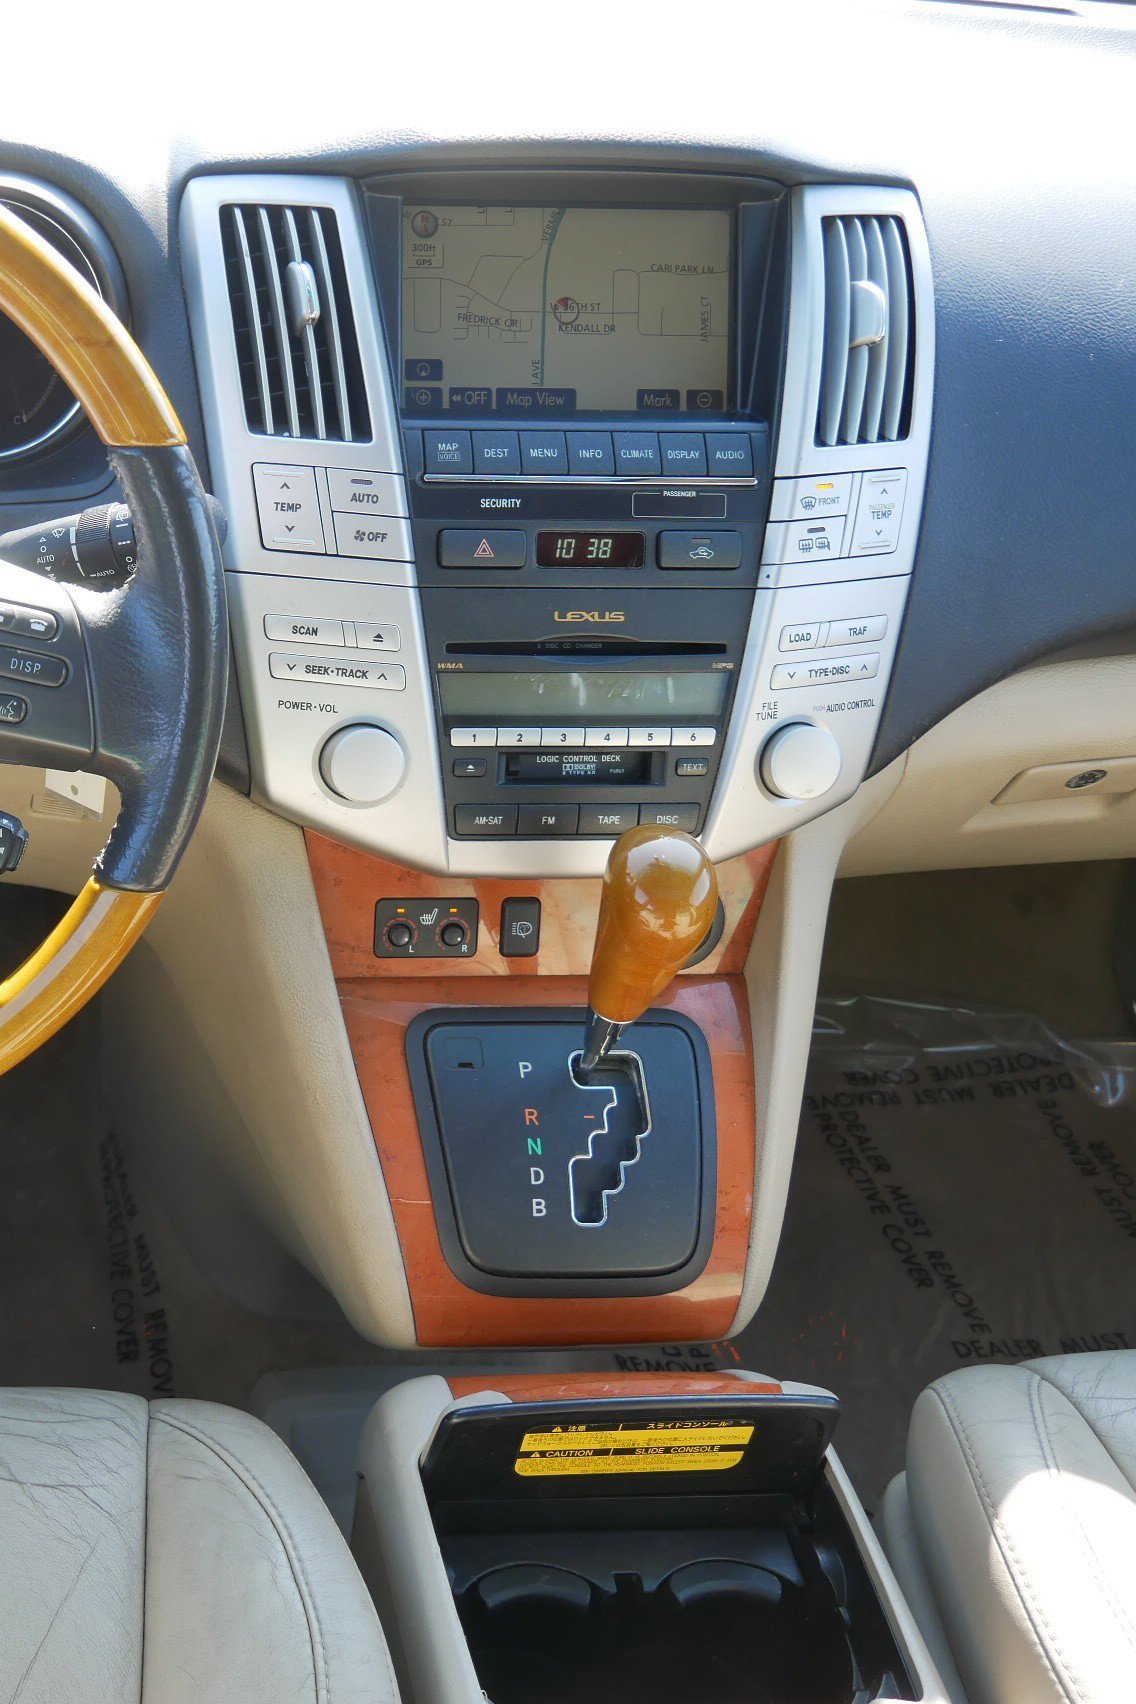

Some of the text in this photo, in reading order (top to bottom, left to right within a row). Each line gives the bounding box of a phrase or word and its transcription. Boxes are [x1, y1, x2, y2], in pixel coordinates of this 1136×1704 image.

[411, 243, 436, 253] 300ft
[416, 259, 433, 267] GPS
[674, 264, 700, 274] PARK
[589, 302, 602, 312] ST
[457, 312, 501, 327] FREDRICK
[558, 323, 616, 333] KENDALL DR
[700, 309, 710, 343] JAMES
[531, 359, 540, 380] AVE
[464, 390, 488, 405] OFF
[506, 391, 566, 408] Map View
[642, 392, 673, 407] Mark
[438, 442, 459, 452] MAP
[483, 448, 509, 458] DEST
[529, 448, 558, 458] MENU
[578, 448, 603, 459] INFO
[620, 449, 654, 459] CLIMATE
[667, 449, 700, 460] DISPLAY
[715, 450, 745, 460] AUDIO
[350, 492, 380, 505] AUTO
[663, 490, 698, 498] PASSENGER
[480, 498, 522, 509] SECURITY
[818, 496, 841, 506] FRONT
[273, 501, 302, 513] TEMP
[870, 510, 893, 520] TEMP
[366, 531, 388, 543] OFF
[36, 553, 55, 565] AUTO
[554, 610, 626, 622] LEXUS
[291, 625, 319, 637] SCAN
[848, 625, 868, 638] TRAF
[788, 632, 813, 644] LOAD
[437, 662, 464, 670] WMA
[761, 701, 779, 711] FILE
[826, 701, 846, 713] AUDIO
[846, 698, 875, 711] CONTROL
[755, 711, 779, 722] TUNE
[471, 733, 477, 744] 1
[516, 733, 524, 743] 2
[560, 733, 568, 743] 3
[603, 733, 611, 742] 4
[646, 733, 654, 742] 5
[690, 733, 697, 742] 6
[536, 754, 621, 763] LOGIC CONTROL DECK
[682, 763, 704, 772] TEXT
[541, 815, 556, 825] FM
[597, 815, 621, 826] TAPE
[655, 814, 680, 825] DISC
[408, 944, 415, 953] L
[461, 944, 468, 952] R
[518, 1061, 532, 1079] P
[524, 1108, 539, 1125] R
[527, 1137, 543, 1155] N
[530, 1167, 545, 1185] D
[531, 1198, 547, 1217] B
[880, 1223, 937, 1289] COVER
[883, 1183, 934, 1240] MUST
[923, 1248, 994, 1335] REMOVE
[112, 1288, 140, 1366] COVER
[951, 1330, 1131, 1360] DEALER MUST
[143, 1307, 176, 1399] REMOV
[614, 1353, 717, 1372] REMOVE
[545, 1449, 594, 1458] CAUTION
[634, 1445, 721, 1455] SLIDE CONSOLE
